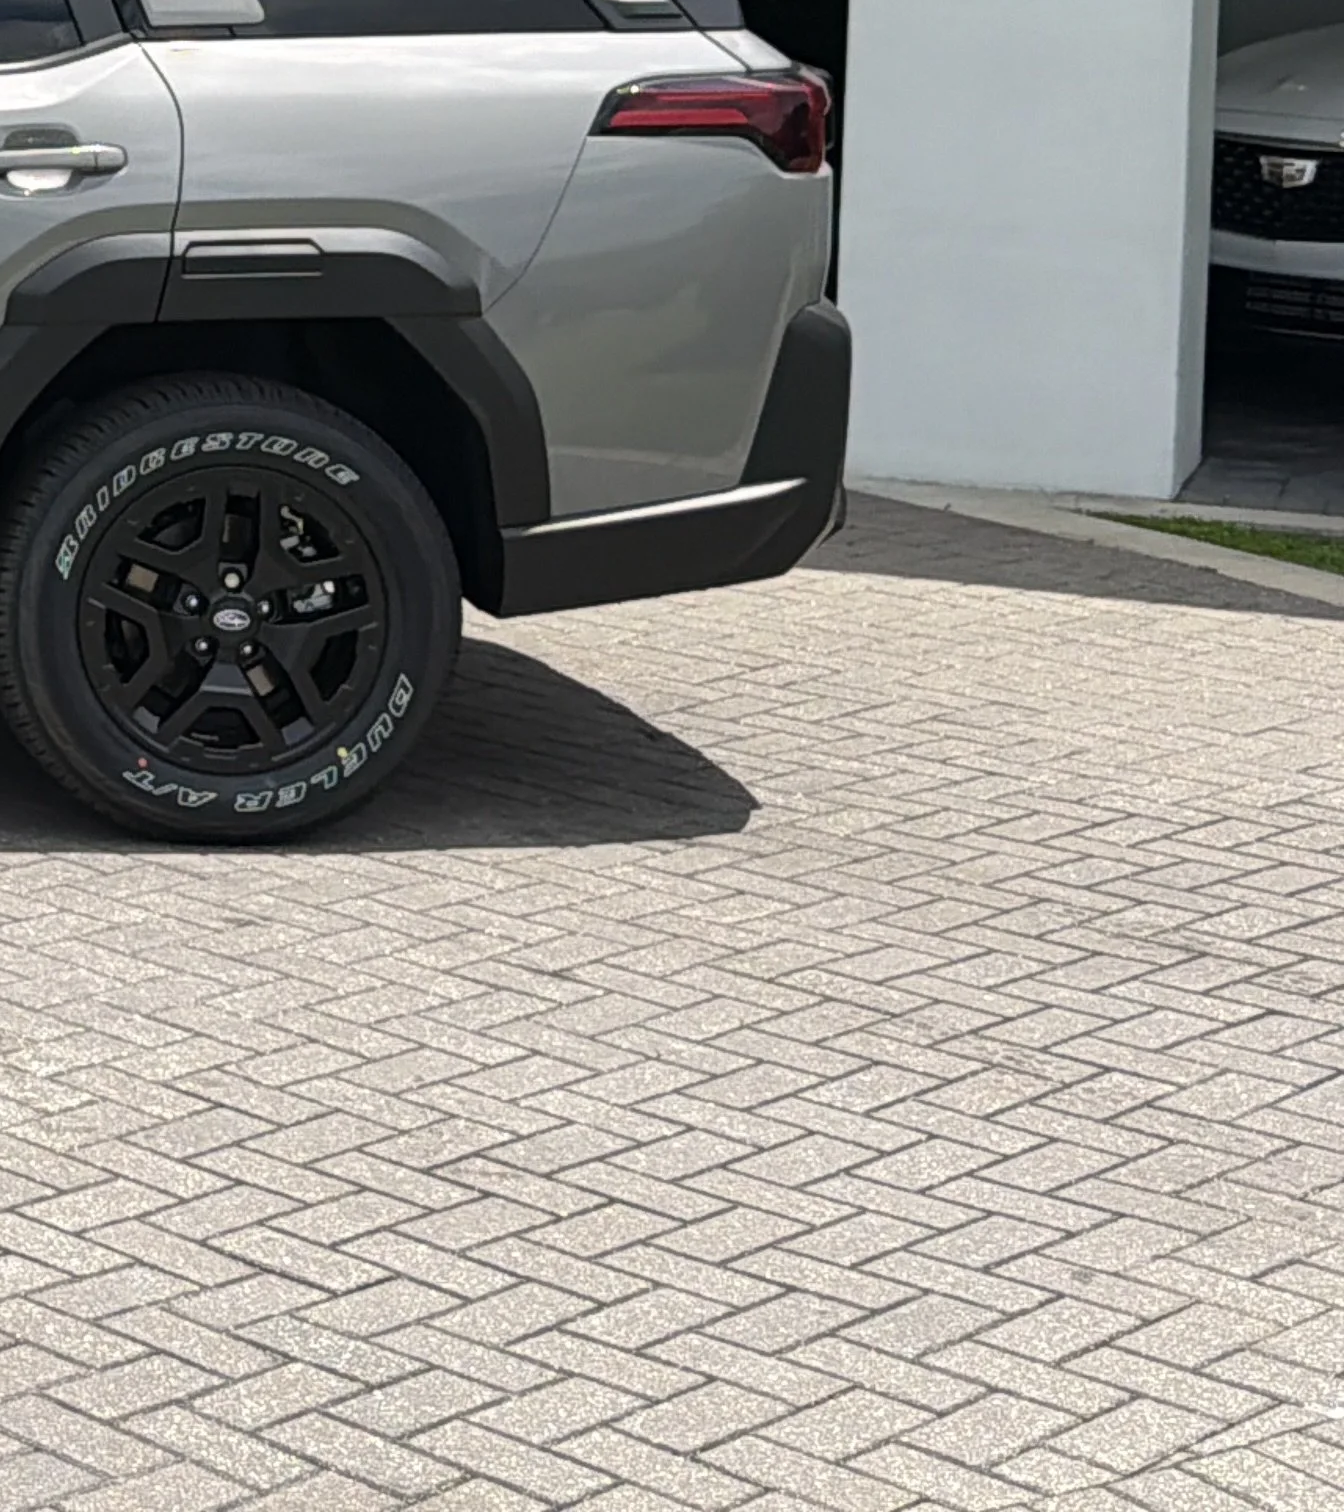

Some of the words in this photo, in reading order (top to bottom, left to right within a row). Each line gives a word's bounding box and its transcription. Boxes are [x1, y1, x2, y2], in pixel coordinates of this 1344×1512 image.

[54, 431, 360, 580] BRIDGESTONE
[122, 770, 219, 809] A/T
[234, 674, 414, 813] DUELER
